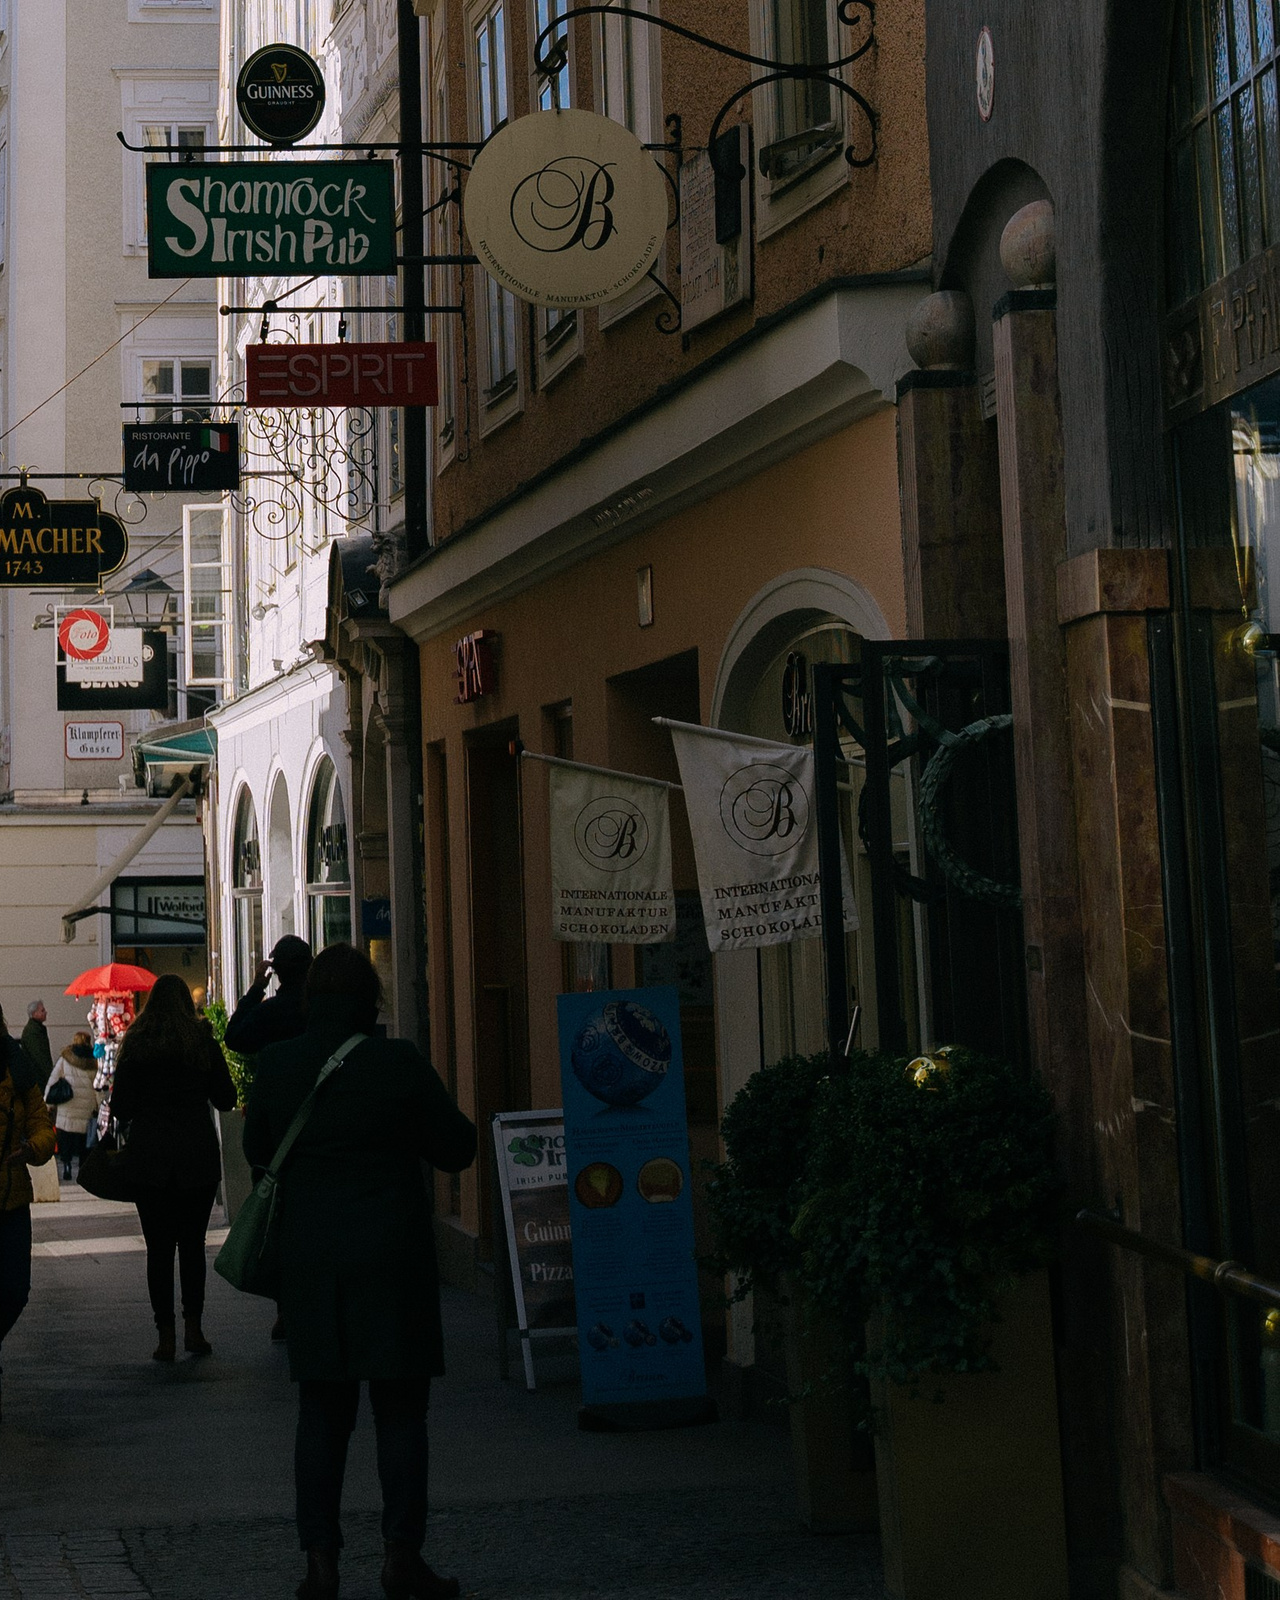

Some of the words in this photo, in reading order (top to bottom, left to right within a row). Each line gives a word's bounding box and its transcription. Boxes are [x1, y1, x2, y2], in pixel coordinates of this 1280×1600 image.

[246, 83, 314, 100] GUINNESS
[165, 176, 376, 257] Shamrock
[210, 217, 297, 263] Irish
[479, 239, 541, 299] INTERNATIONALE
[257, 353, 426, 397] ESPRIT
[132, 431, 191, 441] RISTORANTE
[133, 445, 160, 472] da
[12, 502, 41, 519] M.
[5, 560, 44, 577] 1743
[560, 888, 668, 901] INTERNATIONALE
[560, 906, 668, 918] MANUFAKTUR
[560, 922, 669, 935] SCHOKOLADEN
[516, 1175, 544, 1186] IRISH
[530, 1262, 573, 1282] Pizza
